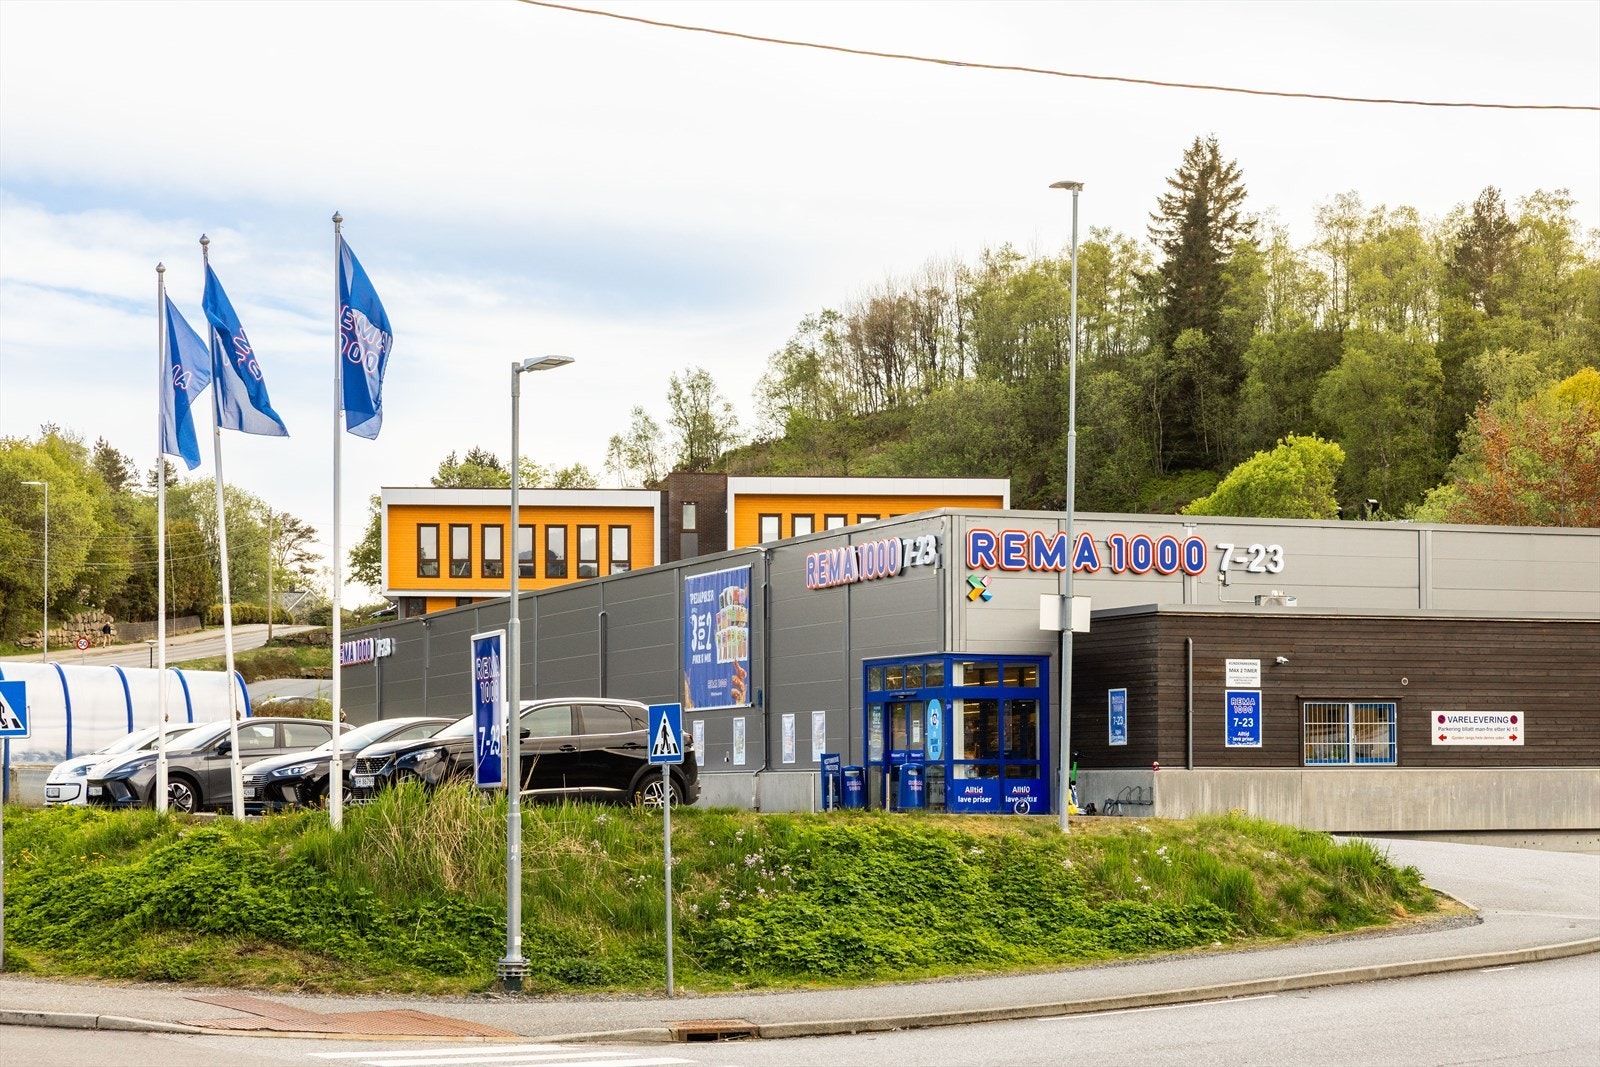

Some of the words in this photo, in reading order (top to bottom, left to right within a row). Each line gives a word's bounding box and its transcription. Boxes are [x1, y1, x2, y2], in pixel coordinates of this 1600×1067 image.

[966, 528, 1100, 573] REMA
[1108, 532, 1207, 576] 1000
[1216, 543, 1285, 573] 7-23
[806, 545, 858, 590] REMA
[858, 537, 902, 582] 1000
[902, 535, 937, 568] 7-23
[79, 640, 88, 648] 50
[340, 641, 356, 667] EMA
[475, 655, 500, 680] REMA
[480, 681, 498, 704] 1000
[1231, 697, 1255, 706] REMA
[1233, 705, 1253, 714] 1000
[1233, 718, 1253, 727] 7-23
[1447, 716, 1509, 724] VARELEVERING
[479, 725, 500, 757] 7-23
[973, 796, 992, 804] priser
